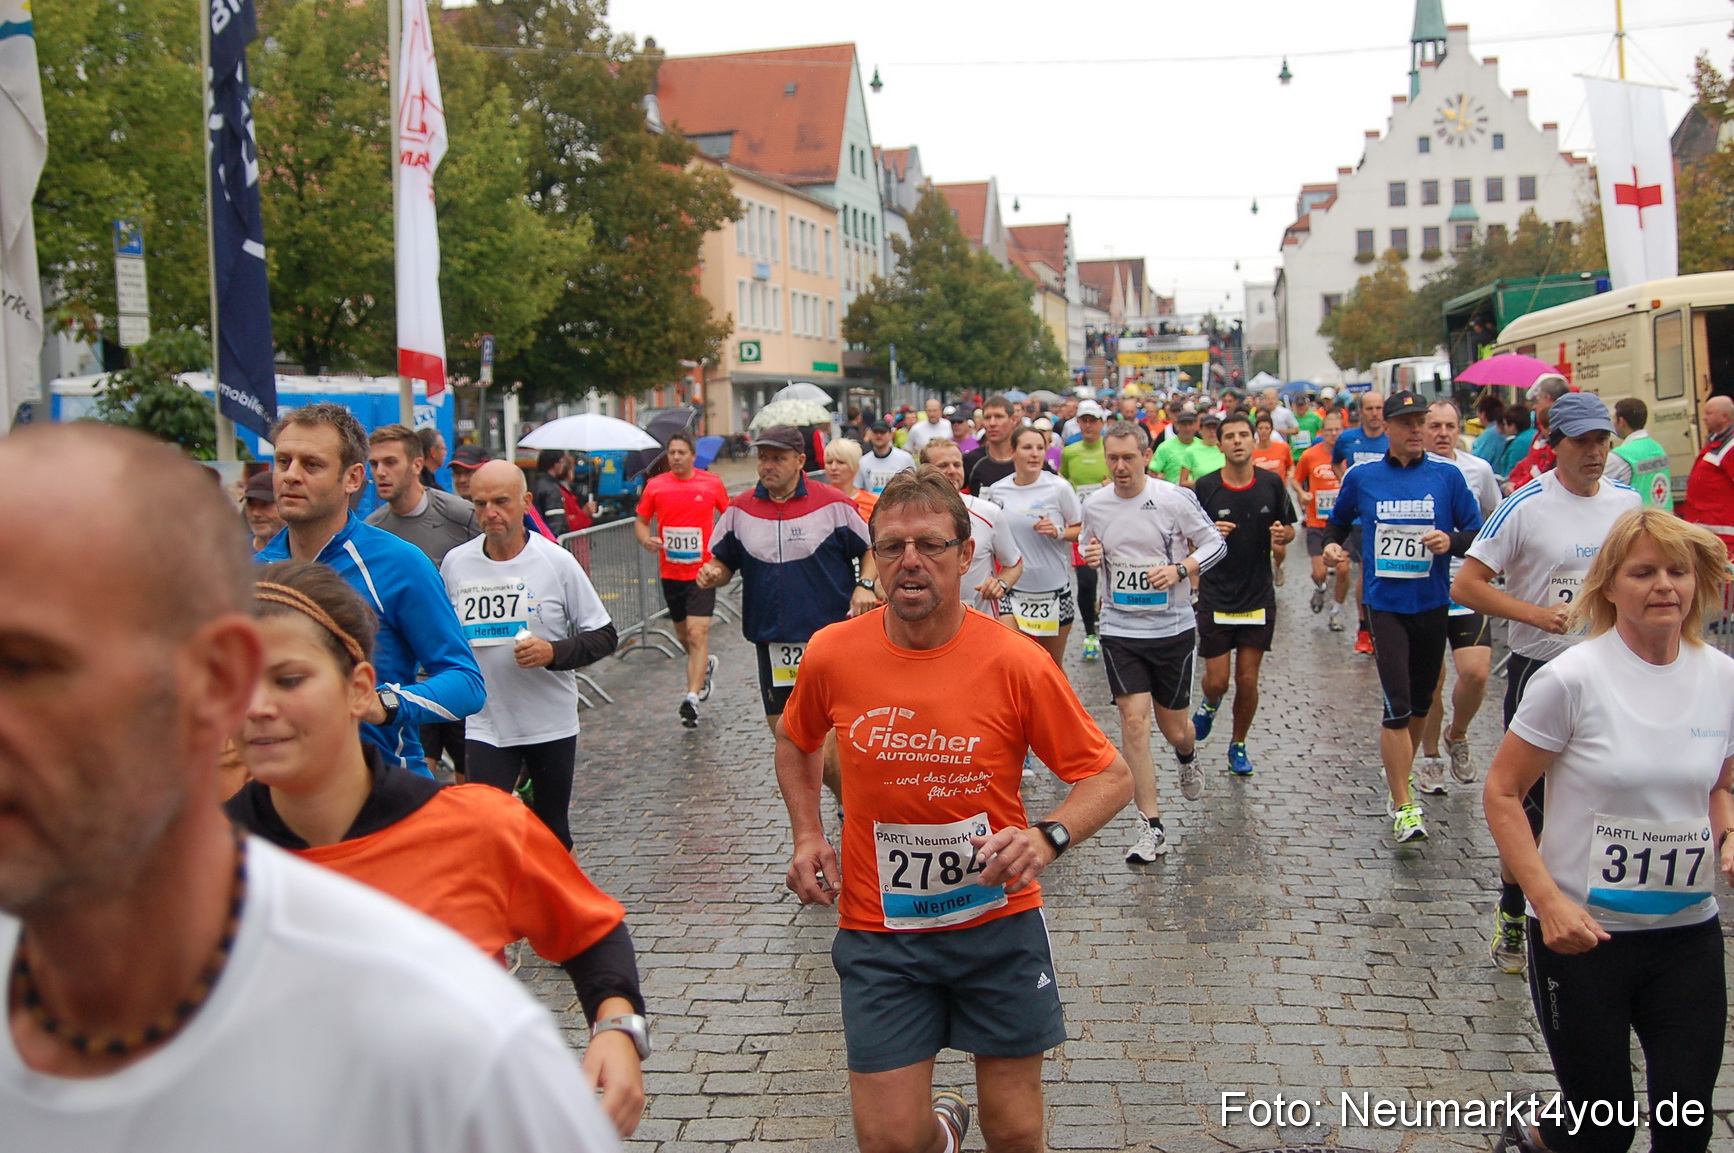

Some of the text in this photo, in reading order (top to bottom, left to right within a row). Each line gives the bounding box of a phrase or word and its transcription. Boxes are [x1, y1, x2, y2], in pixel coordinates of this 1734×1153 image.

[741, 342, 759, 361] D
[1376, 500, 1435, 513] HUBER
[667, 537, 698, 550] 2019
[1380, 537, 1426, 558] 2761
[481, 584, 514, 592] Neumarkt
[1116, 570, 1158, 591] 246
[1551, 578, 1578, 586] PARTL
[464, 594, 520, 621] 2037
[1020, 602, 1050, 618] 223
[474, 626, 510, 636] Herbert
[780, 645, 804, 666] 32
[867, 726, 981, 753] Fischer
[876, 751, 972, 765] AUTOMOBILE
[896, 773, 921, 786] und
[923, 772, 947, 784] das
[927, 786, 962, 801] fährt
[876, 831, 972, 847] PARTL Neumarkt
[1596, 825, 1698, 842] PARTL Neumarkt
[1601, 843, 1706, 887] 3117
[912, 893, 972, 915] Werner
